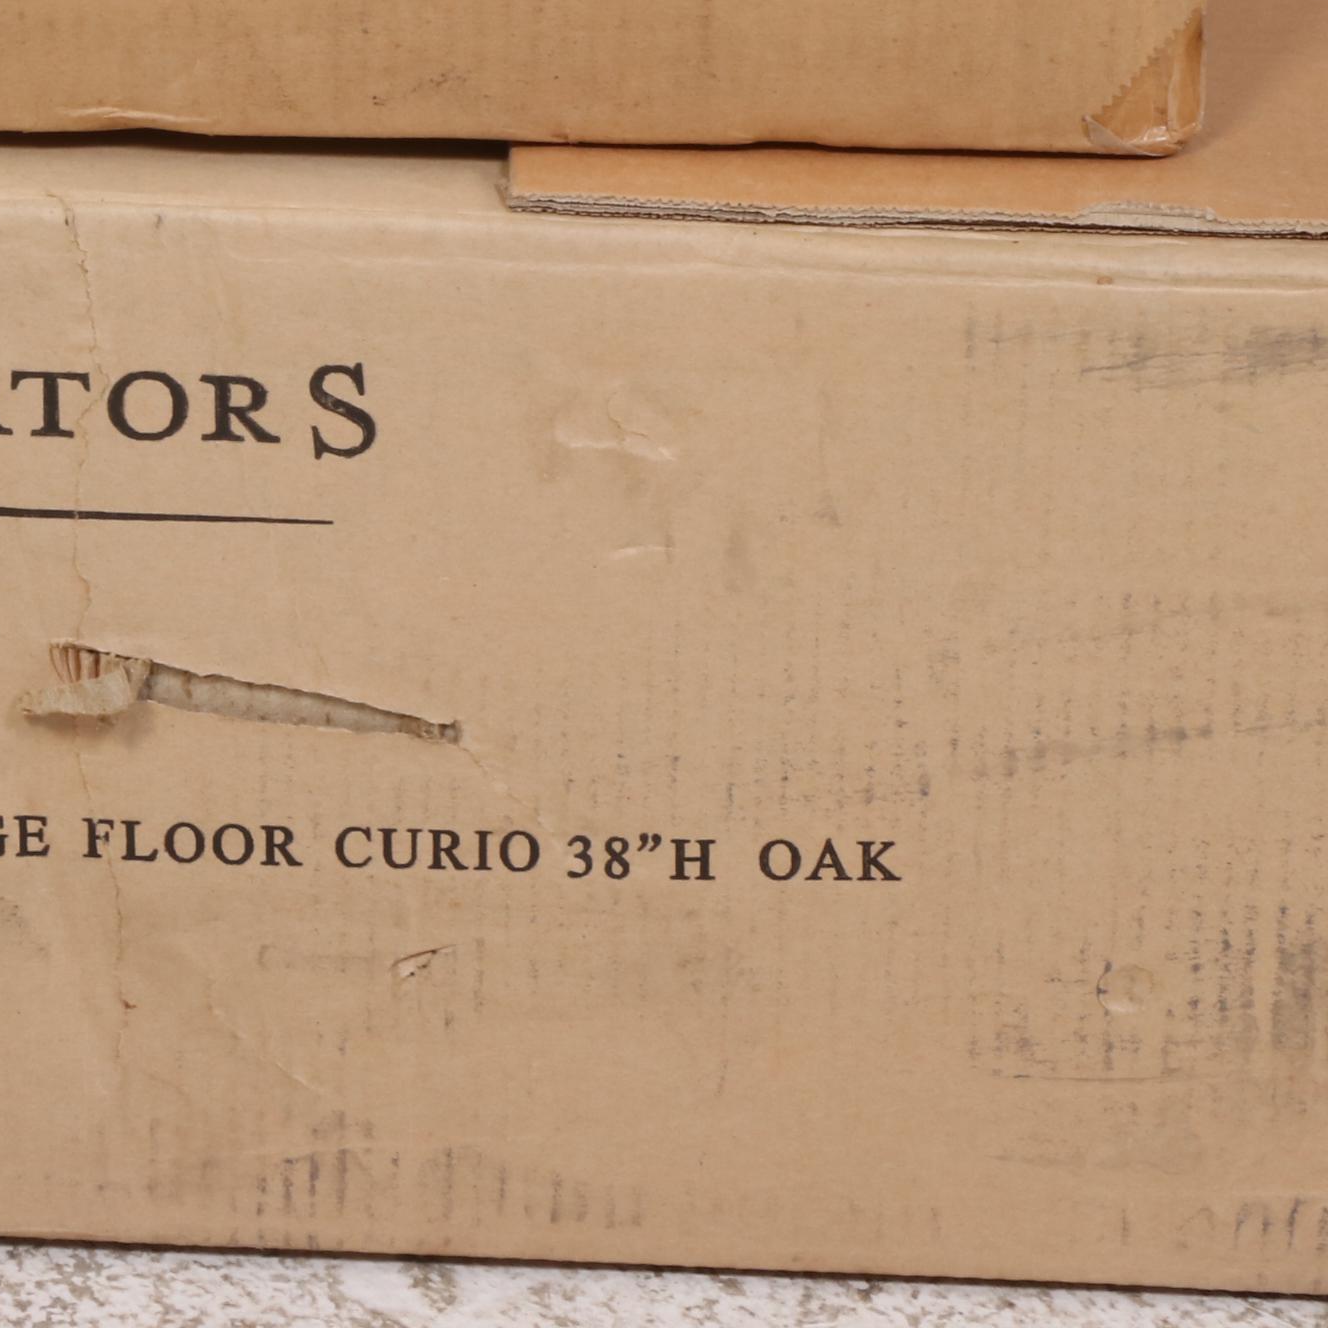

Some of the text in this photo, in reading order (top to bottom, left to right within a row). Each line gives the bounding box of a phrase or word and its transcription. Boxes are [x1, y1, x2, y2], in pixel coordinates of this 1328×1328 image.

[81, 817, 304, 867] FLOOR
[334, 826, 541, 873] CURIO
[758, 837, 902, 882] OAK
